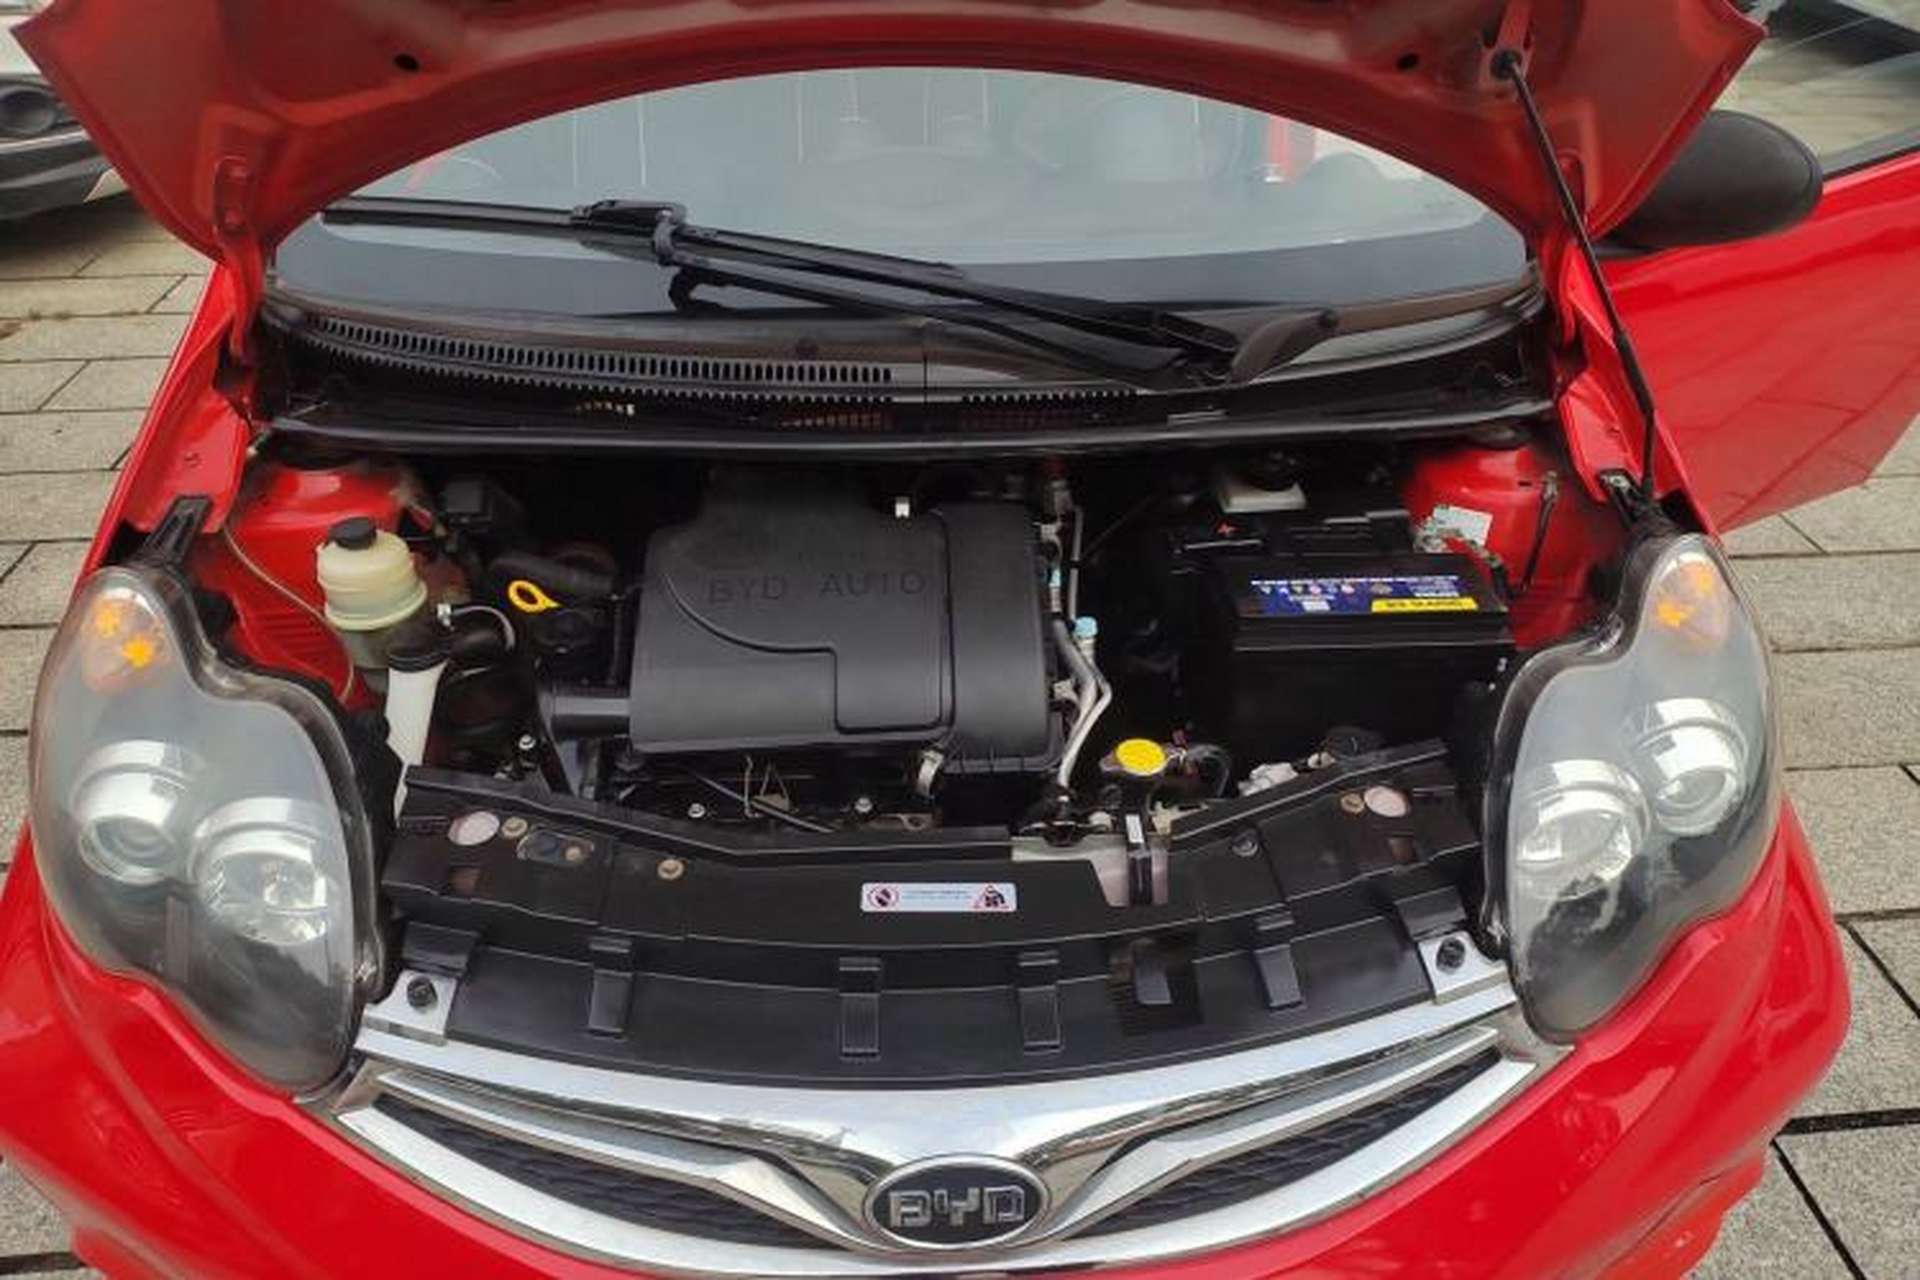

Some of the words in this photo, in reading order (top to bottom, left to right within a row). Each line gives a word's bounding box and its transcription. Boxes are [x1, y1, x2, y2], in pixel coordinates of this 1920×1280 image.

[709, 575, 787, 602] BYD
[820, 571, 925, 597] AUTO
[889, 1185, 1025, 1227] BYD
